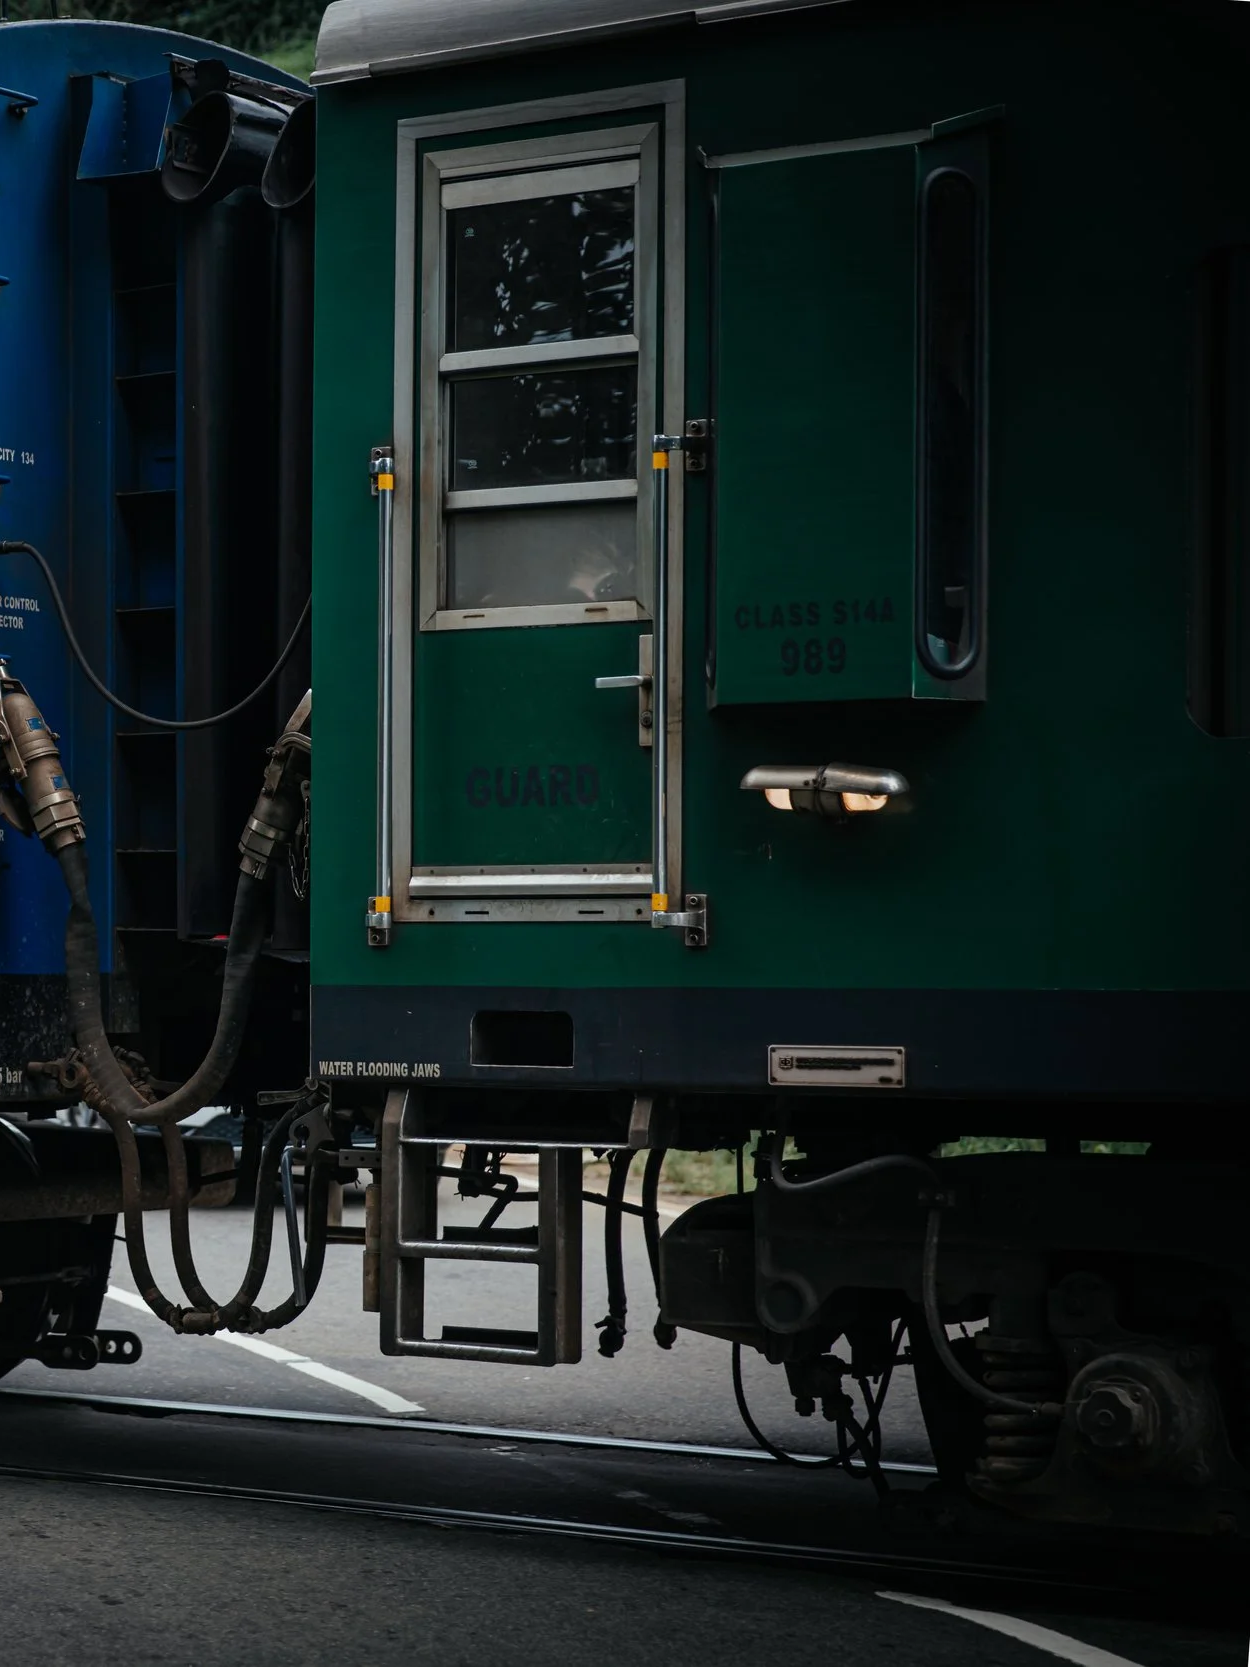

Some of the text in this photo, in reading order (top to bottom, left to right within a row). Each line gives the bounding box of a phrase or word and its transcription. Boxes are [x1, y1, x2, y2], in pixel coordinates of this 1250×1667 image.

[20, 451, 35, 466] 134
[3, 595, 40, 613] CONTROL
[734, 600, 822, 632] CLASS
[780, 636, 847, 677] 989
[465, 764, 600, 808] GUARD
[5, 1066, 23, 1084] bar
[318, 1060, 441, 1078] WATER FLOODING JAWS
